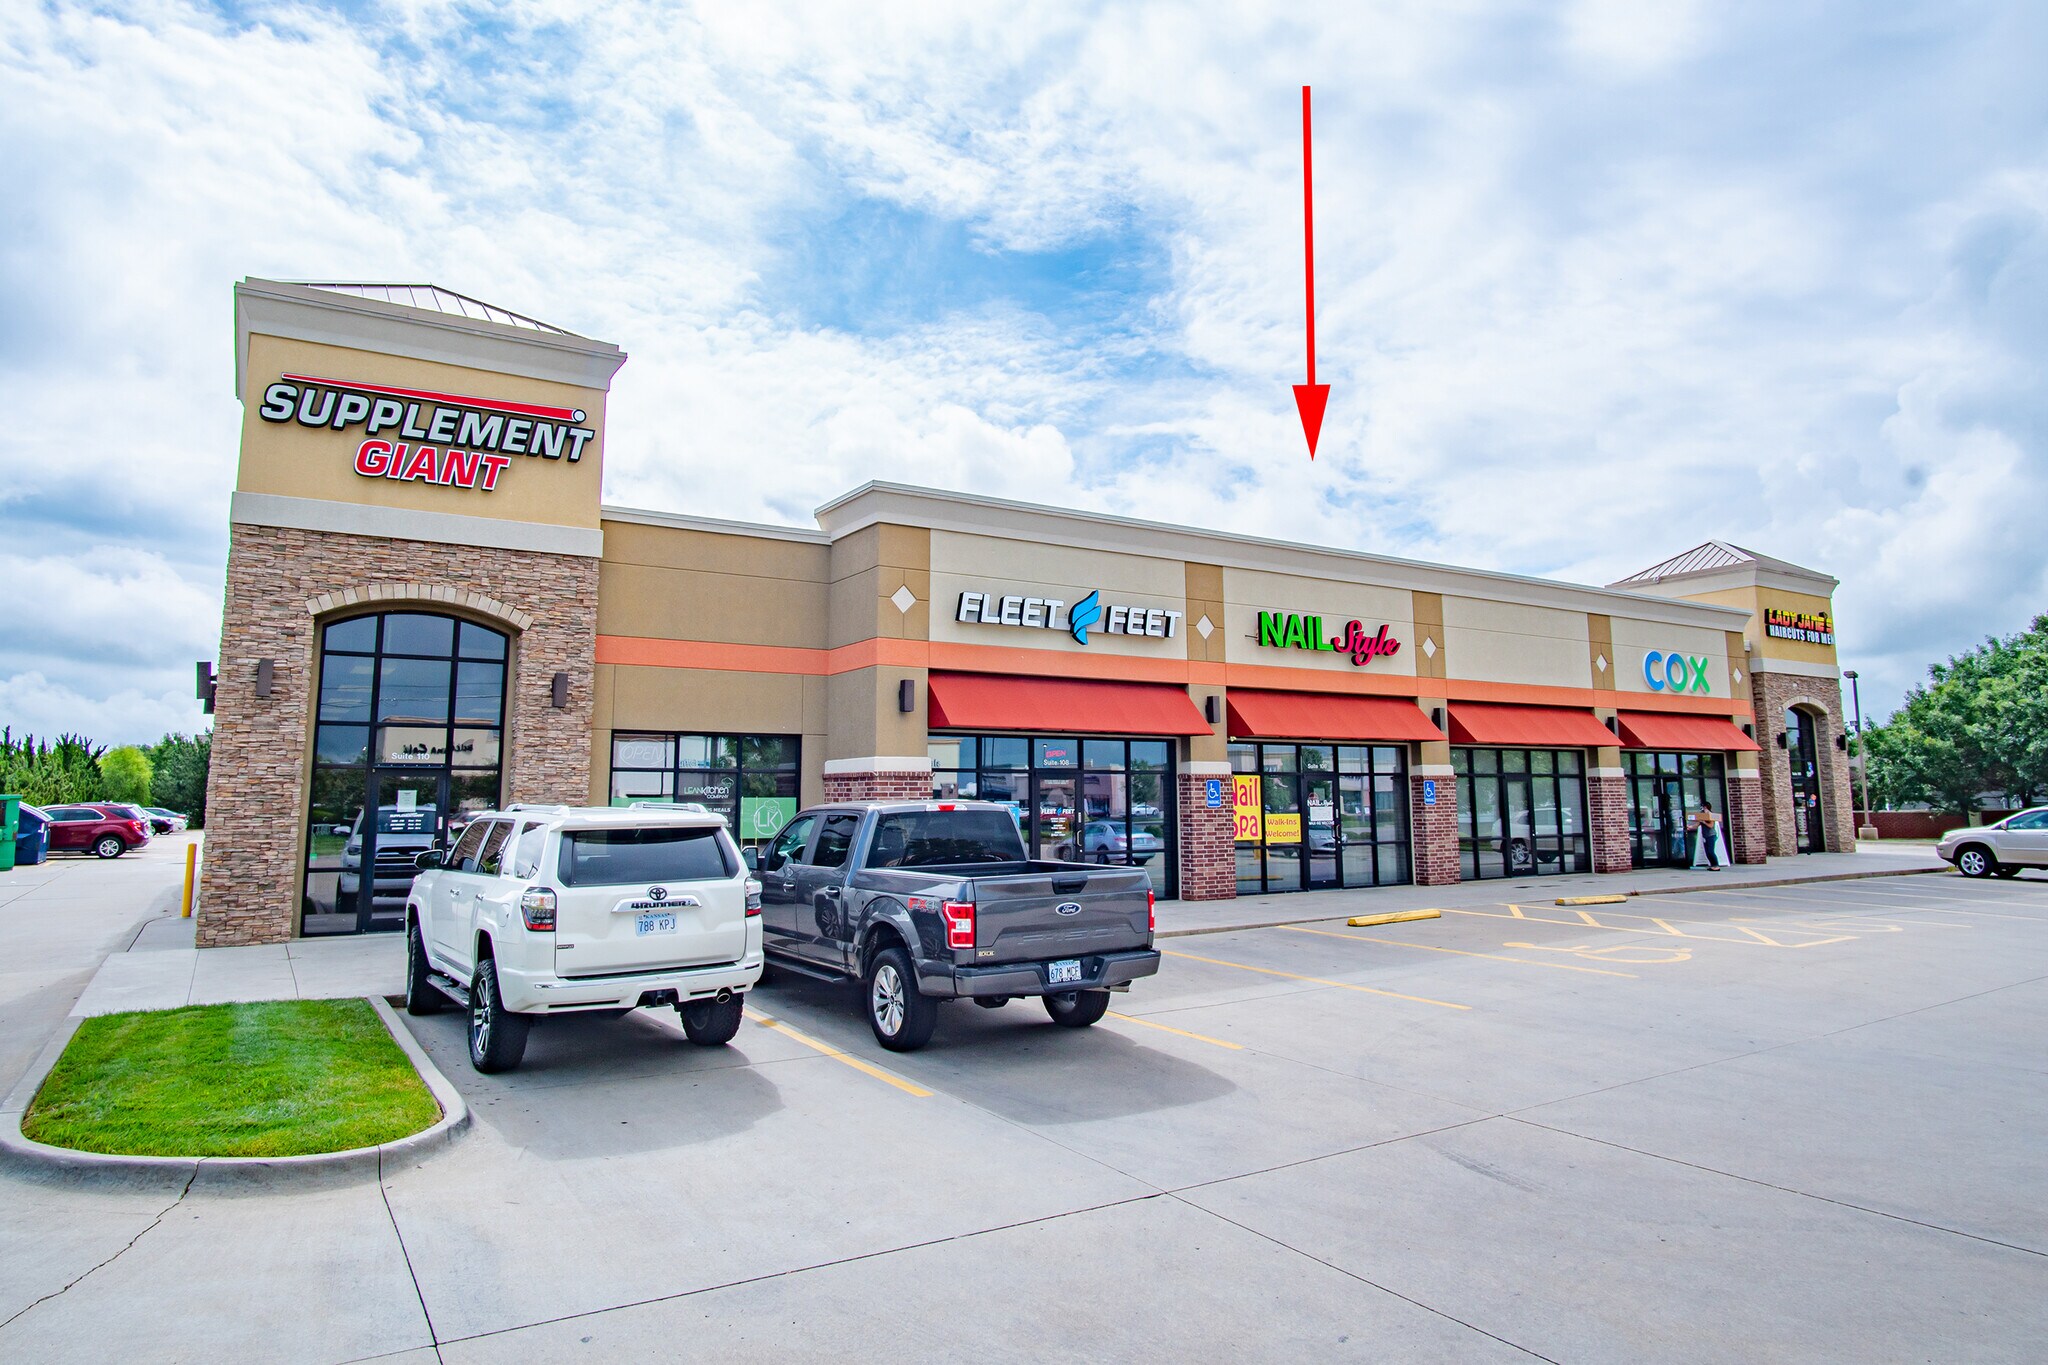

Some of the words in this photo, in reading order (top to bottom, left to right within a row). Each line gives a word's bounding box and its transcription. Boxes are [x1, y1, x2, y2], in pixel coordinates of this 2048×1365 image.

[260, 383, 595, 463] SUPPLEMENT
[354, 438, 512, 491] GIANT
[956, 591, 1064, 629] FLEET
[1104, 605, 1183, 638] FEET
[1765, 608, 1797, 627] LADY
[1797, 612, 1833, 633] JANE'S
[1258, 611, 1334, 651] NAIL
[1331, 619, 1401, 666] Style
[1767, 625, 1805, 641] HAIRCUTS
[1806, 630, 1820, 643] FOR
[1643, 650, 1711, 694] COX
[391, 752, 413, 760] Suite
[417, 752, 430, 760] 110
[626, 742, 662, 761] OPEN
[1045, 750, 1067, 758] OPEN
[757, 812, 779, 831] LK
[1267, 818, 1297, 826] Walk-Ins
[631, 901, 687, 910] 4RUNNER
[908, 897, 937, 910] FX4
[1060, 904, 1077, 914] Ford
[638, 921, 655, 932] 788
[660, 918, 676, 931] KPJ
[1050, 967, 1064, 979] 678
